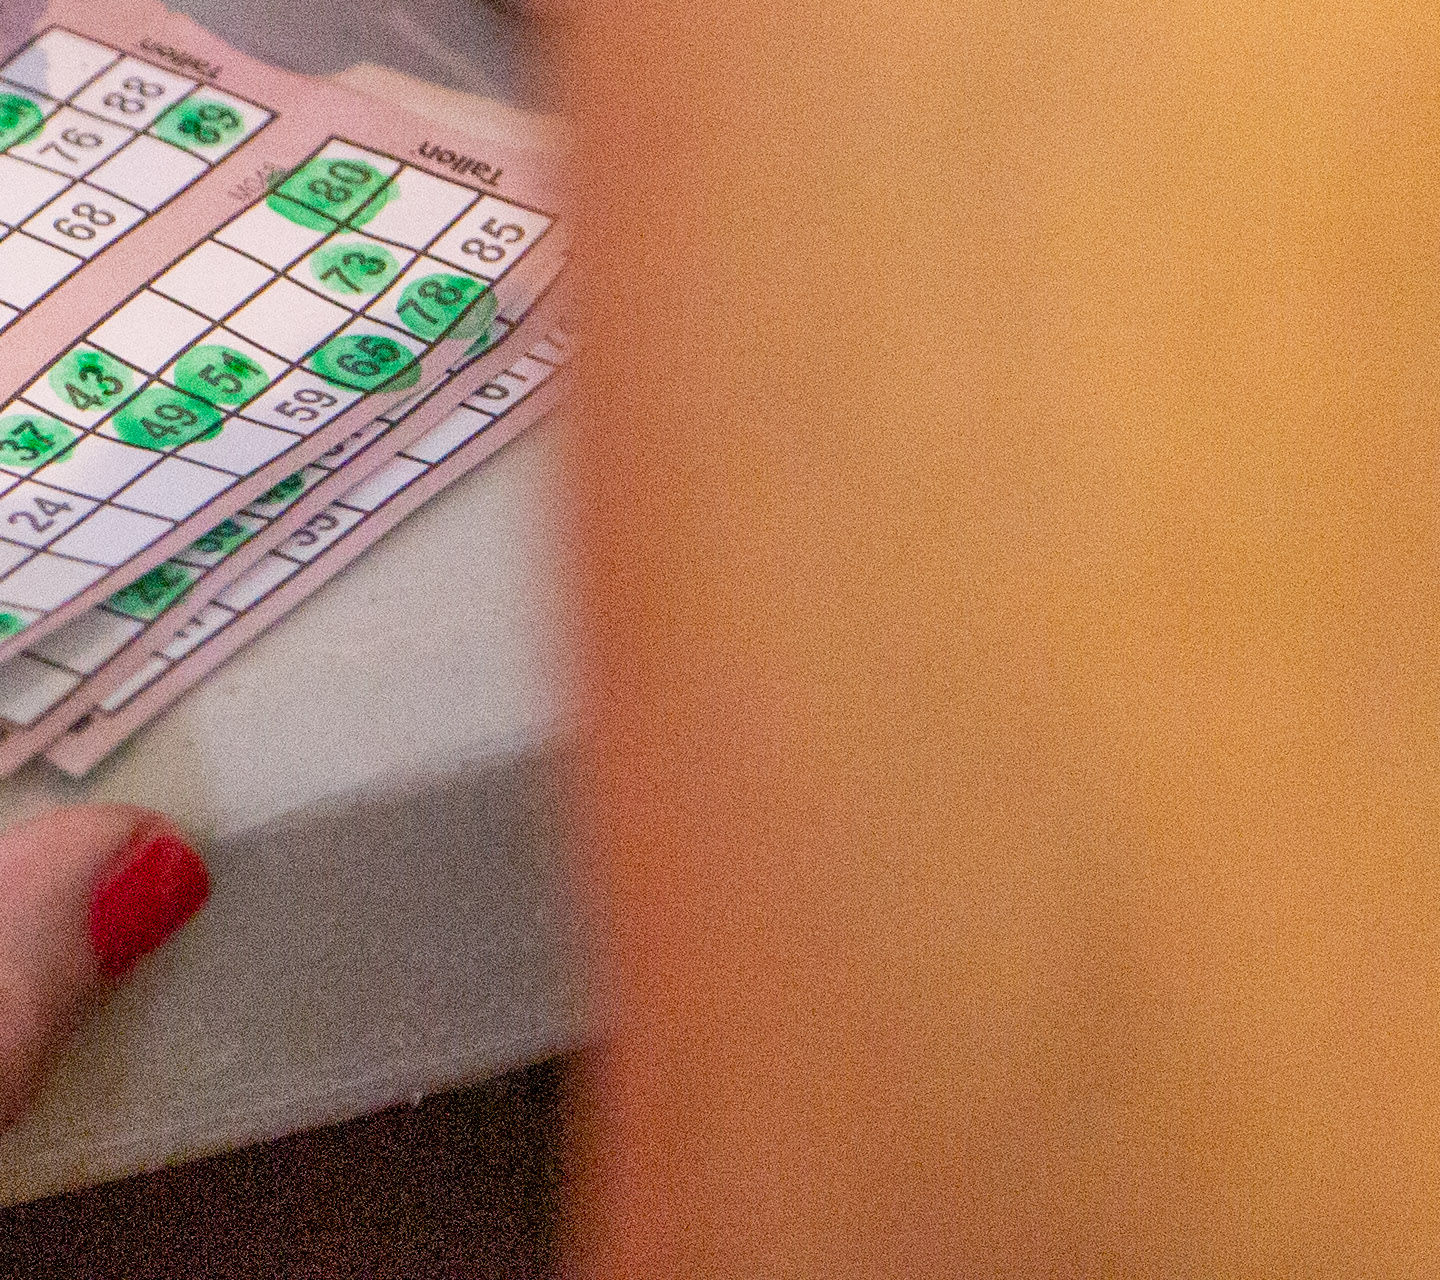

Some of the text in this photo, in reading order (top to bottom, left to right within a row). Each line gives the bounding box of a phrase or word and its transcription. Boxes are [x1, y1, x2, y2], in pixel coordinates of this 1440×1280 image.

[38, 127, 105, 164] 76
[101, 78, 166, 115] 88
[52, 202, 117, 241] 68
[177, 107, 240, 145] 89
[416, 140, 504, 188] Tallon
[64, 363, 125, 412] 43
[307, 161, 373, 205] 80
[273, 216, 527, 423] 59 65 78 85
[6, 496, 73, 535] 24
[139, 403, 200, 442] 49
[197, 351, 261, 396] 51
[319, 251, 387, 292] 73
